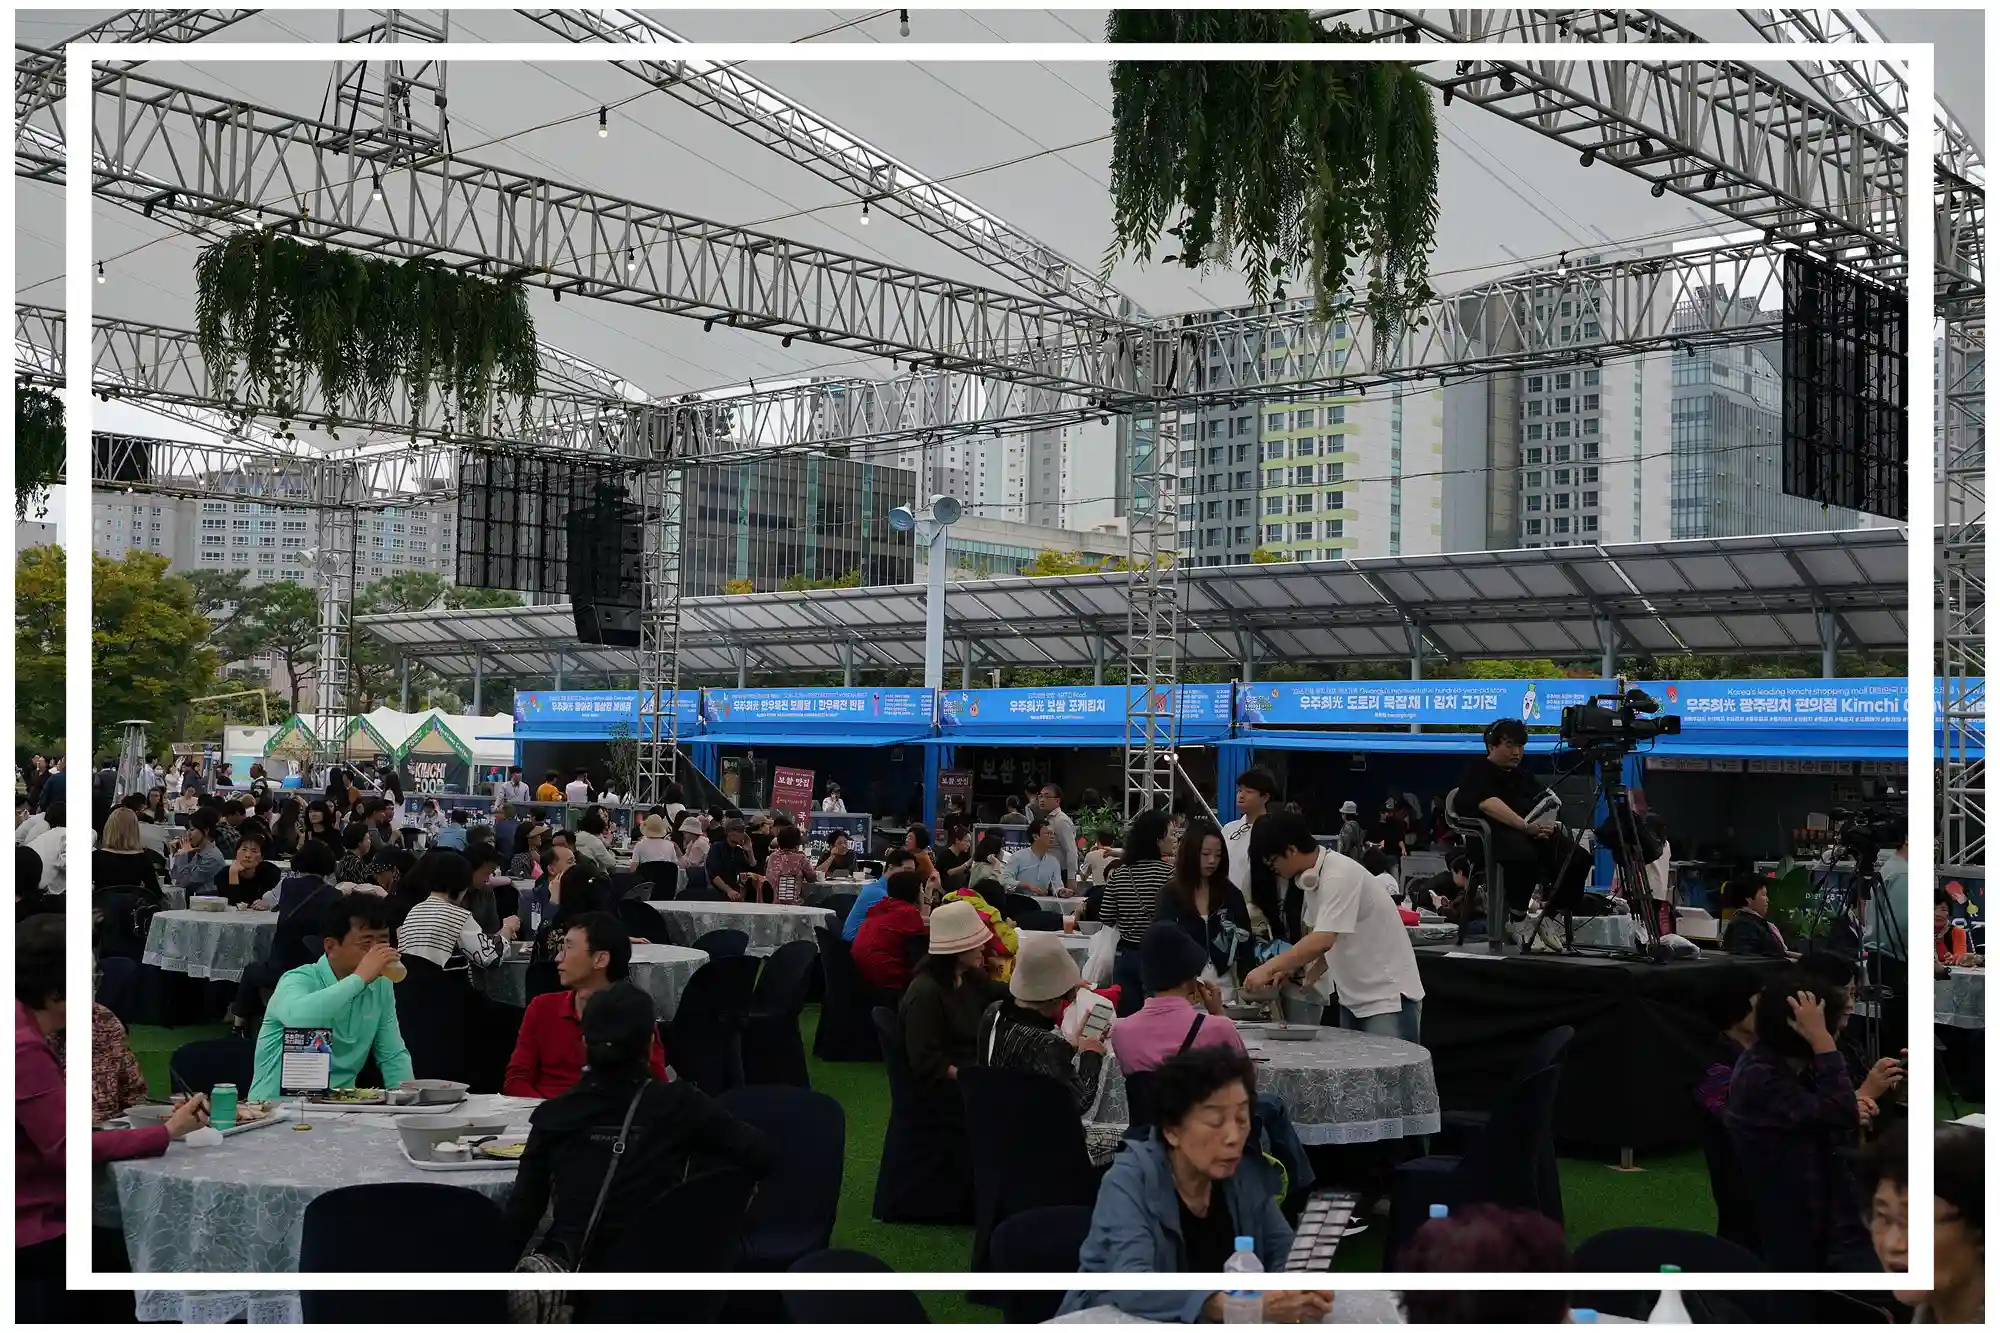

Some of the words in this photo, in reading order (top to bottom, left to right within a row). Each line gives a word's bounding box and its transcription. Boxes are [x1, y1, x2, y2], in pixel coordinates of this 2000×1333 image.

[1757, 687, 1786, 697] leading
[1347, 695, 1379, 710] 도토리
[1686, 698, 1736, 713] 우주최光
[1740, 697, 1792, 713] 광주김치
[1795, 697, 1838, 713] 편의점
[1841, 697, 1899, 713] Kimchi
[414, 761, 447, 779] KIMCHI
[795, 777, 810, 788] 맛집
